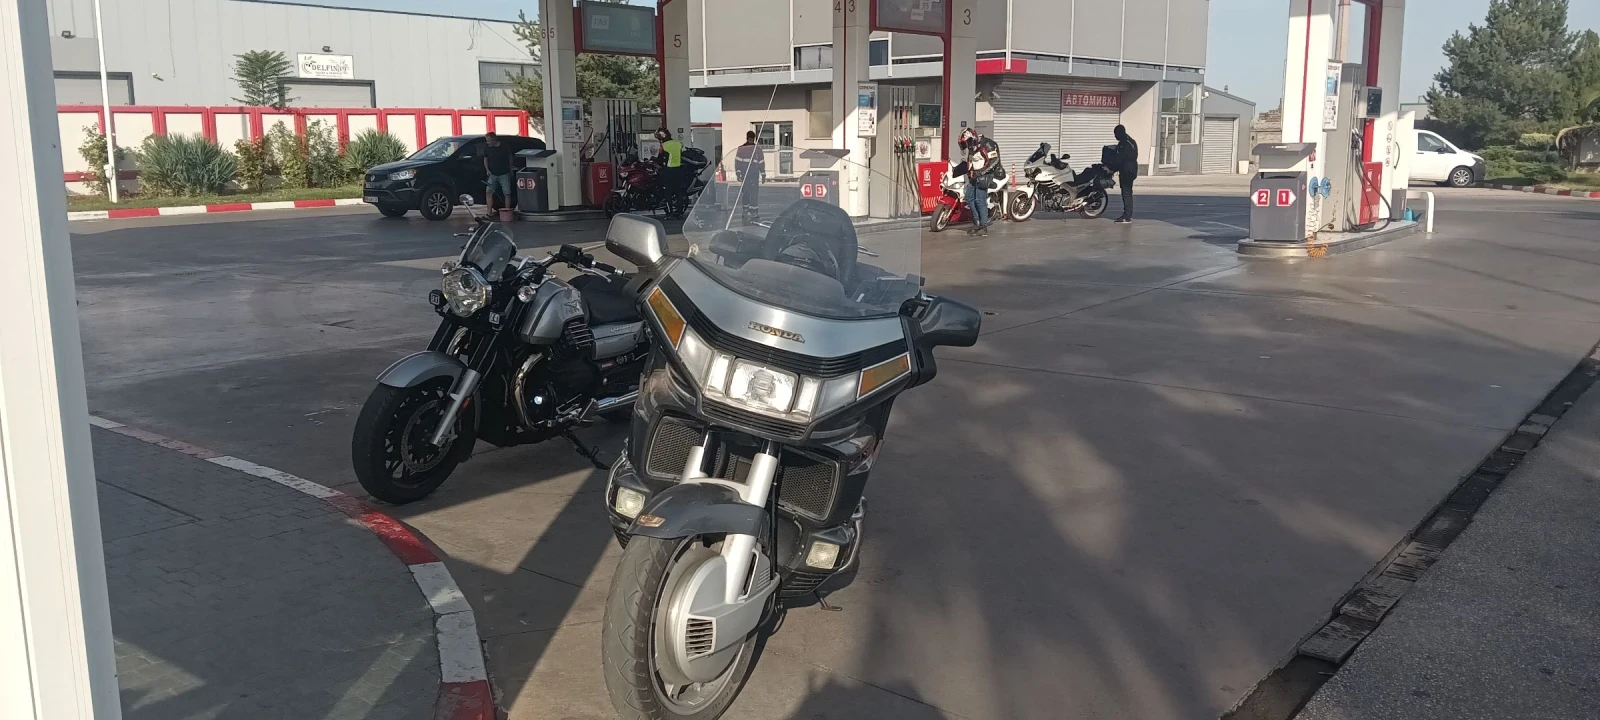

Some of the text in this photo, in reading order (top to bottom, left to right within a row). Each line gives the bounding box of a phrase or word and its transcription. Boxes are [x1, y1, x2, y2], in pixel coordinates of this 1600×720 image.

[834, 1, 842, 13] 4
[848, 0, 856, 12] 3
[963, 9, 972, 25] 3
[541, 29, 546, 39] 6
[549, 28, 555, 39] 5
[673, 34, 682, 48] 5
[1066, 95, 1117, 106] АВТОМИВКА
[1260, 193, 1267, 202] 2
[1281, 193, 1286, 202] 1
[748, 321, 806, 343] HONDA
